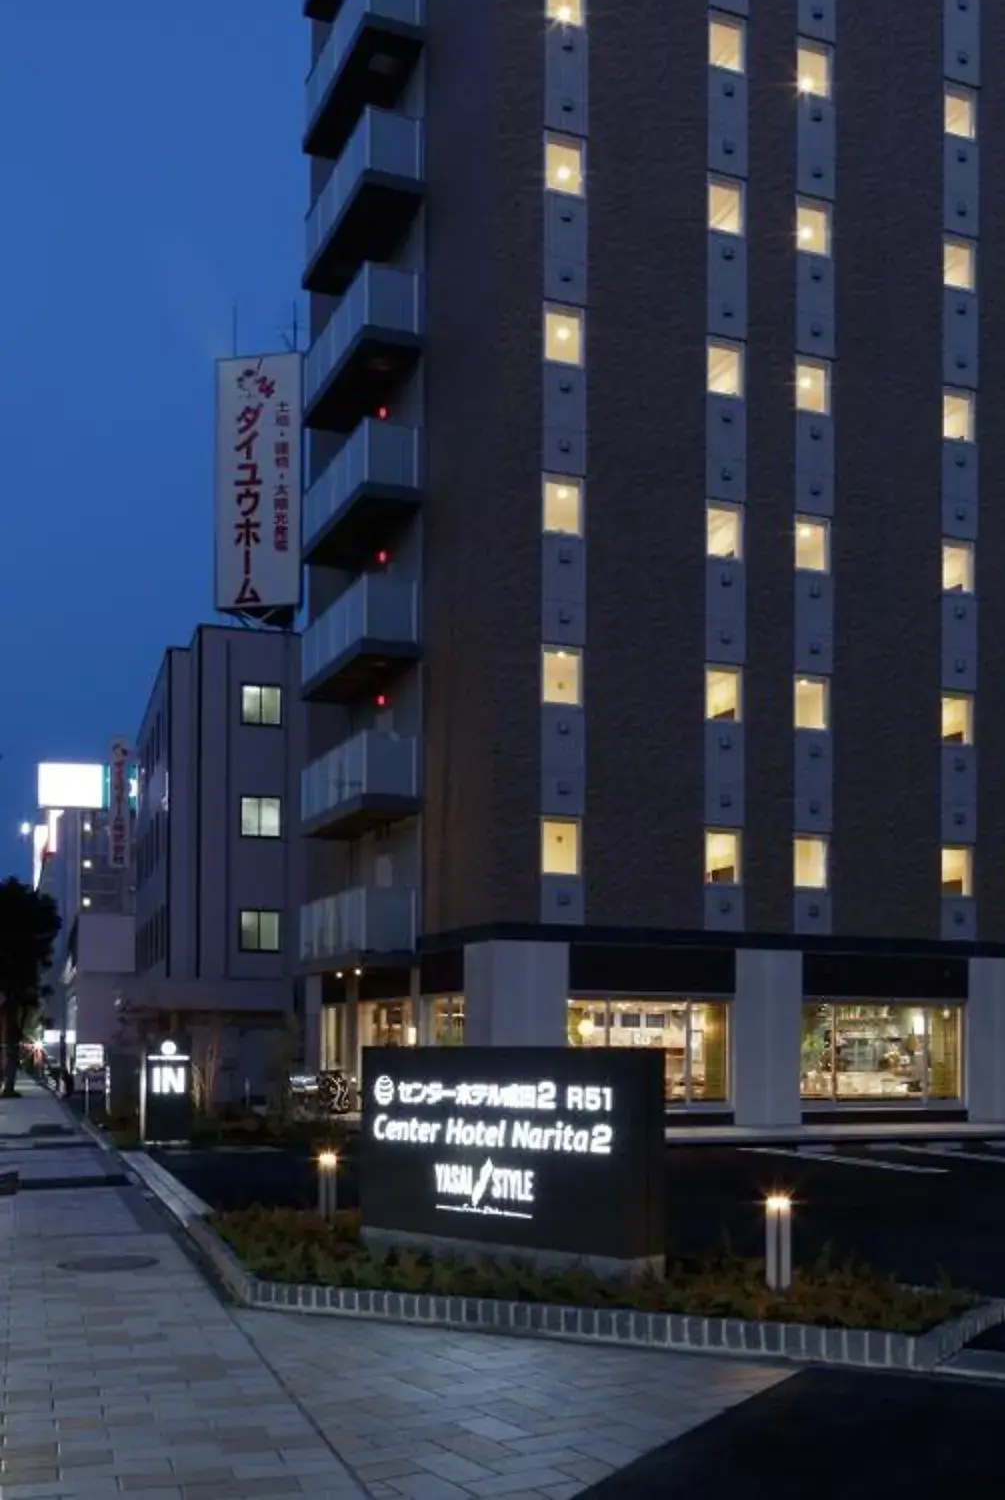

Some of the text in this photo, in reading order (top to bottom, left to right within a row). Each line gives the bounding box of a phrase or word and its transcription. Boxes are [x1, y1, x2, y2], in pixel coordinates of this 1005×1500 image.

[234, 402, 263, 605] ダイユウホーム
[151, 1066, 186, 1095] IN
[567, 1086, 612, 1111] R51
[374, 1115, 613, 1154] Center Hotel Narita2
[434, 1163, 535, 1202] YASAI STYLE
